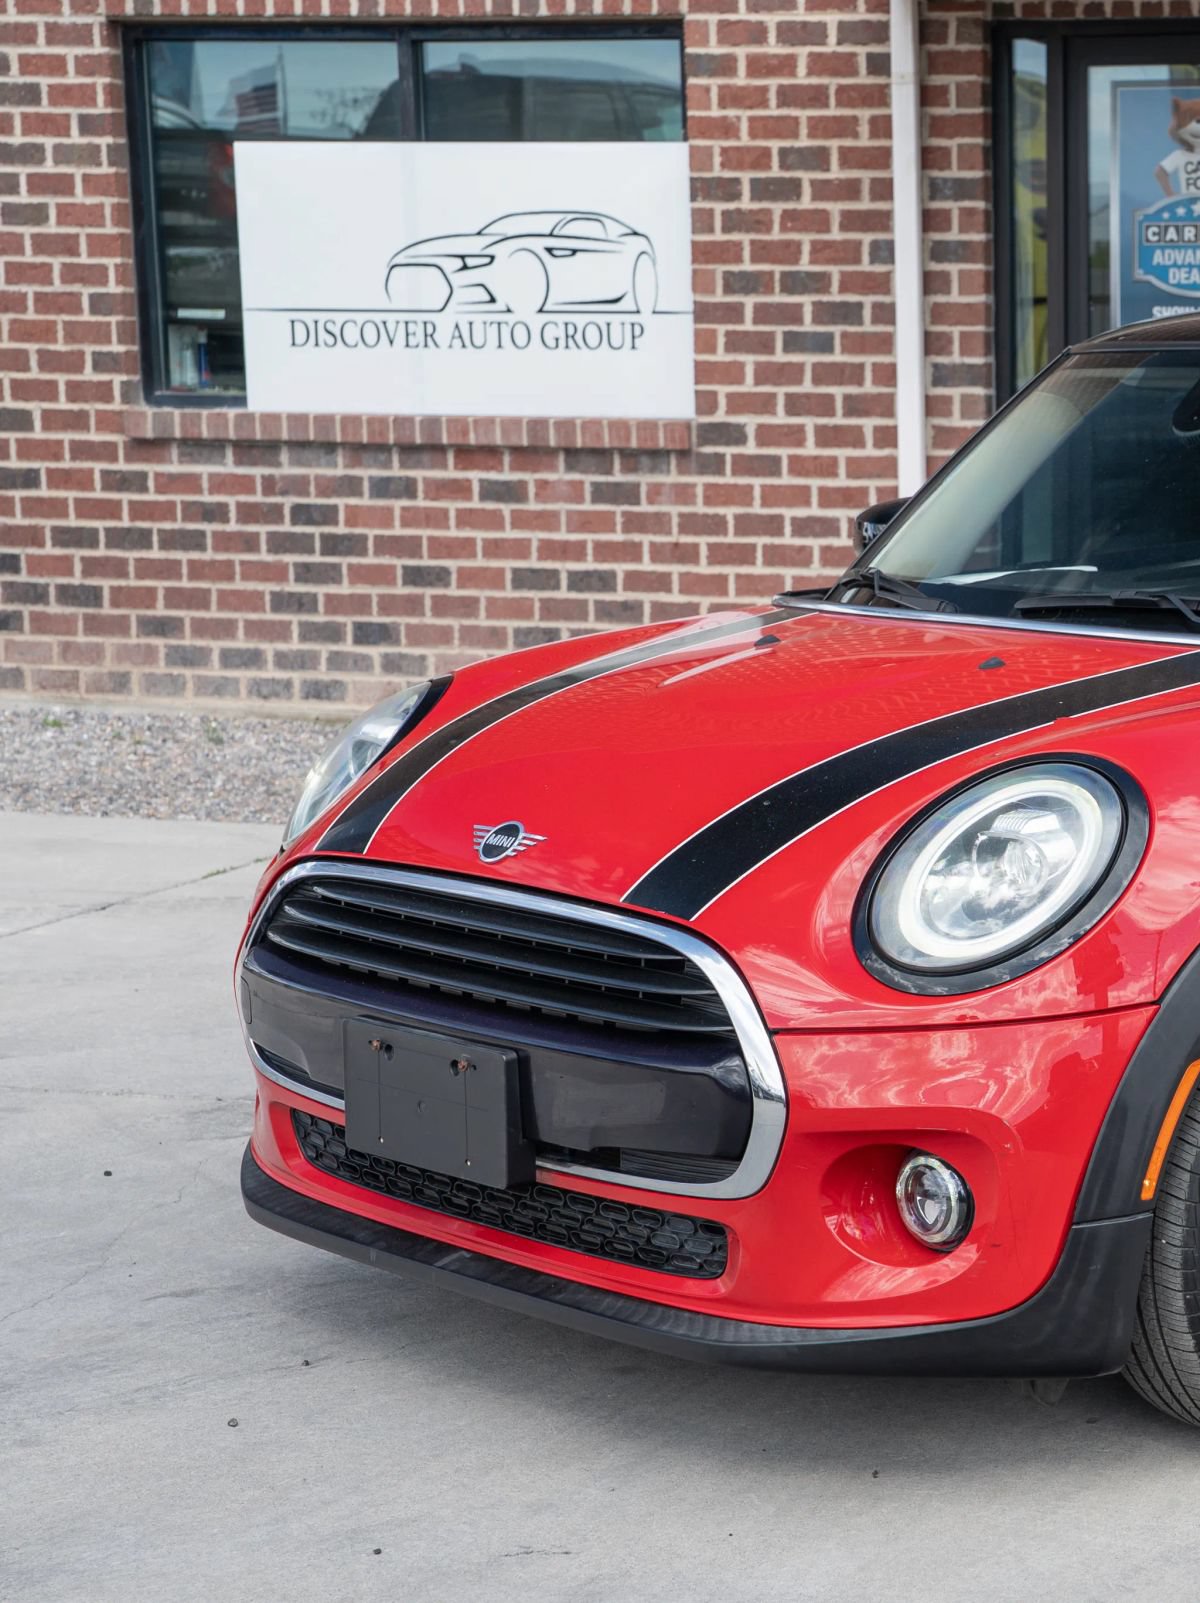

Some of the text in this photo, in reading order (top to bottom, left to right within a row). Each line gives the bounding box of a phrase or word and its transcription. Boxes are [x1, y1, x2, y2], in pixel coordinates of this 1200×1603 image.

[289, 319, 645, 350] DISCOVER AUTO GROUP
[486, 833, 515, 848] MINI
